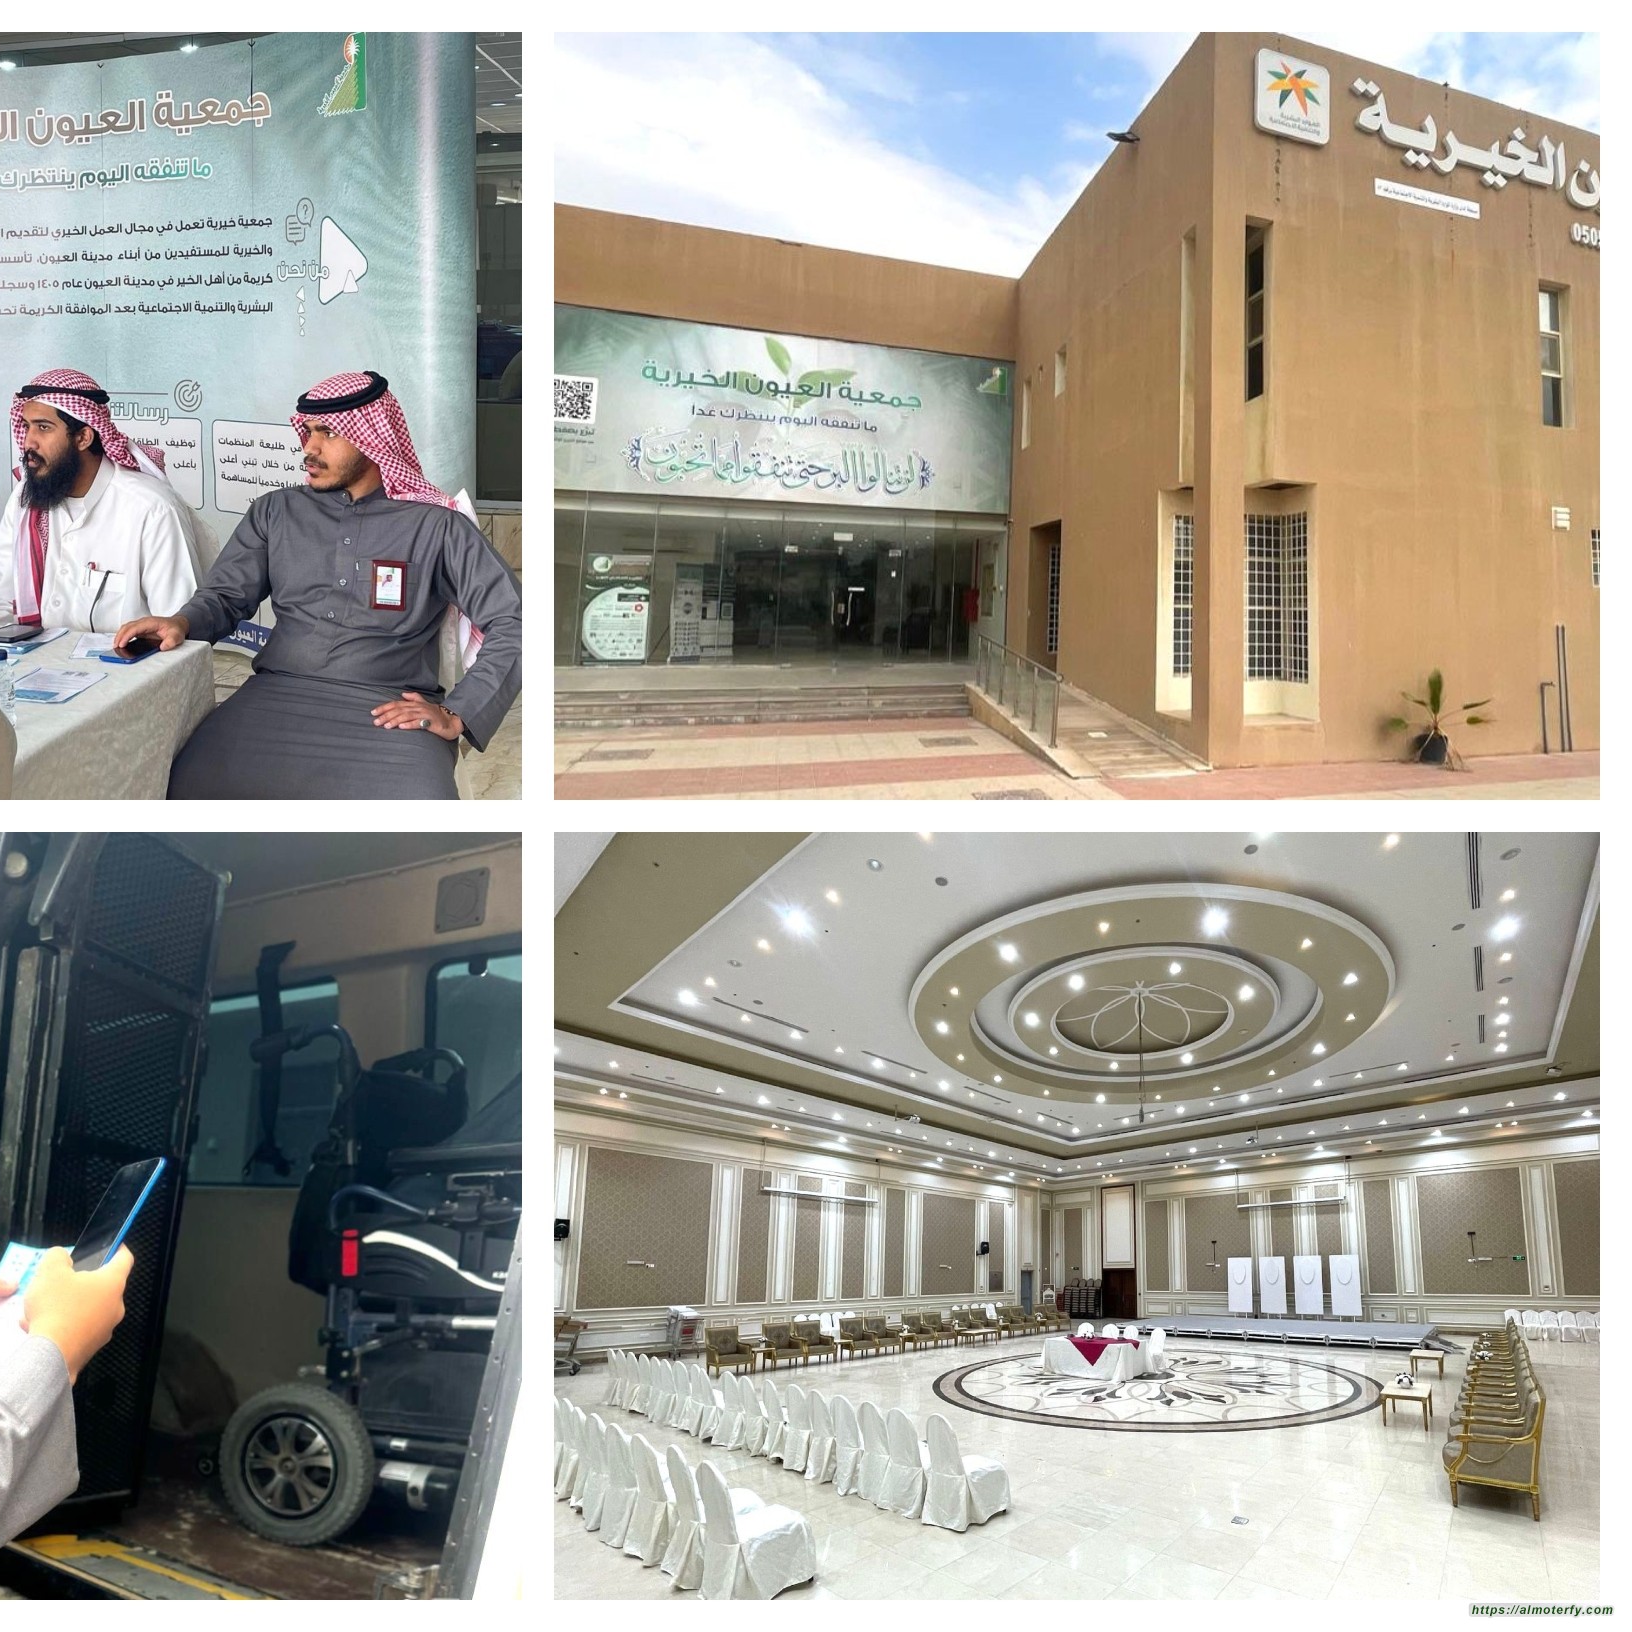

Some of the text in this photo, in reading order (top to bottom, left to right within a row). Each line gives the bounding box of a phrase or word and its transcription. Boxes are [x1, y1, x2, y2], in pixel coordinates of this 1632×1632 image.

[153, 90, 272, 136] جمعية
[25, 98, 145, 147] العيون
[1350, 77, 1566, 190] الخيرية
[134, 157, 190, 182] تنفقه
[190, 157, 213, 179] ما
[78, 161, 131, 190] اليوم
[175, 218, 205, 232] تعمل
[207, 217, 236, 230] خيرية
[238, 214, 273, 228] جمعية
[6, 226, 49, 240] لتقديم
[51, 225, 87, 241] الخيري
[88, 223, 123, 236] العمل
[125, 222, 154, 235] مجال
[155, 221, 173, 237] في
[81, 250, 113, 263] مدينة
[118, 246, 141, 261] أبناء
[144, 247, 161, 260] من
[165, 245, 230, 259] للمستفيدين
[233, 243, 273, 257] والخيرية
[277, 260, 330, 282] من نحن
[37, 279, 59, 288] ١٤٠٥
[61, 279, 83, 291] عام
[84, 276, 122, 290] العيون
[123, 274, 155, 288] مدينة
[157, 275, 174, 291] في
[176, 274, 202, 288] الخير
[205, 271, 225, 286] أهل
[227, 272, 242, 285] من
[243, 272, 273, 287] كريمة
[19, 304, 63, 316] الكريمة
[65, 302, 112, 316] الموافقة
[114, 303, 136, 315] بعد
[138, 301, 192, 315] الاجتماعية
[194, 301, 235, 315] والتنمية
[238, 301, 273, 315] البشرية
[642, 360, 922, 411] جمعية العيون الخيرية
[864, 421, 878, 433] ما
[165, 439, 196, 449] توظيف
[218, 437, 254, 448] المنظمات
[259, 439, 285, 451] طليعة
[173, 459, 197, 471] بأعلى
[219, 454, 238, 464] أعلى
[241, 457, 258, 469] تبني
[261, 459, 279, 469] خلال
[283, 461, 295, 472] من
[221, 471, 257, 484] للمساهمة
